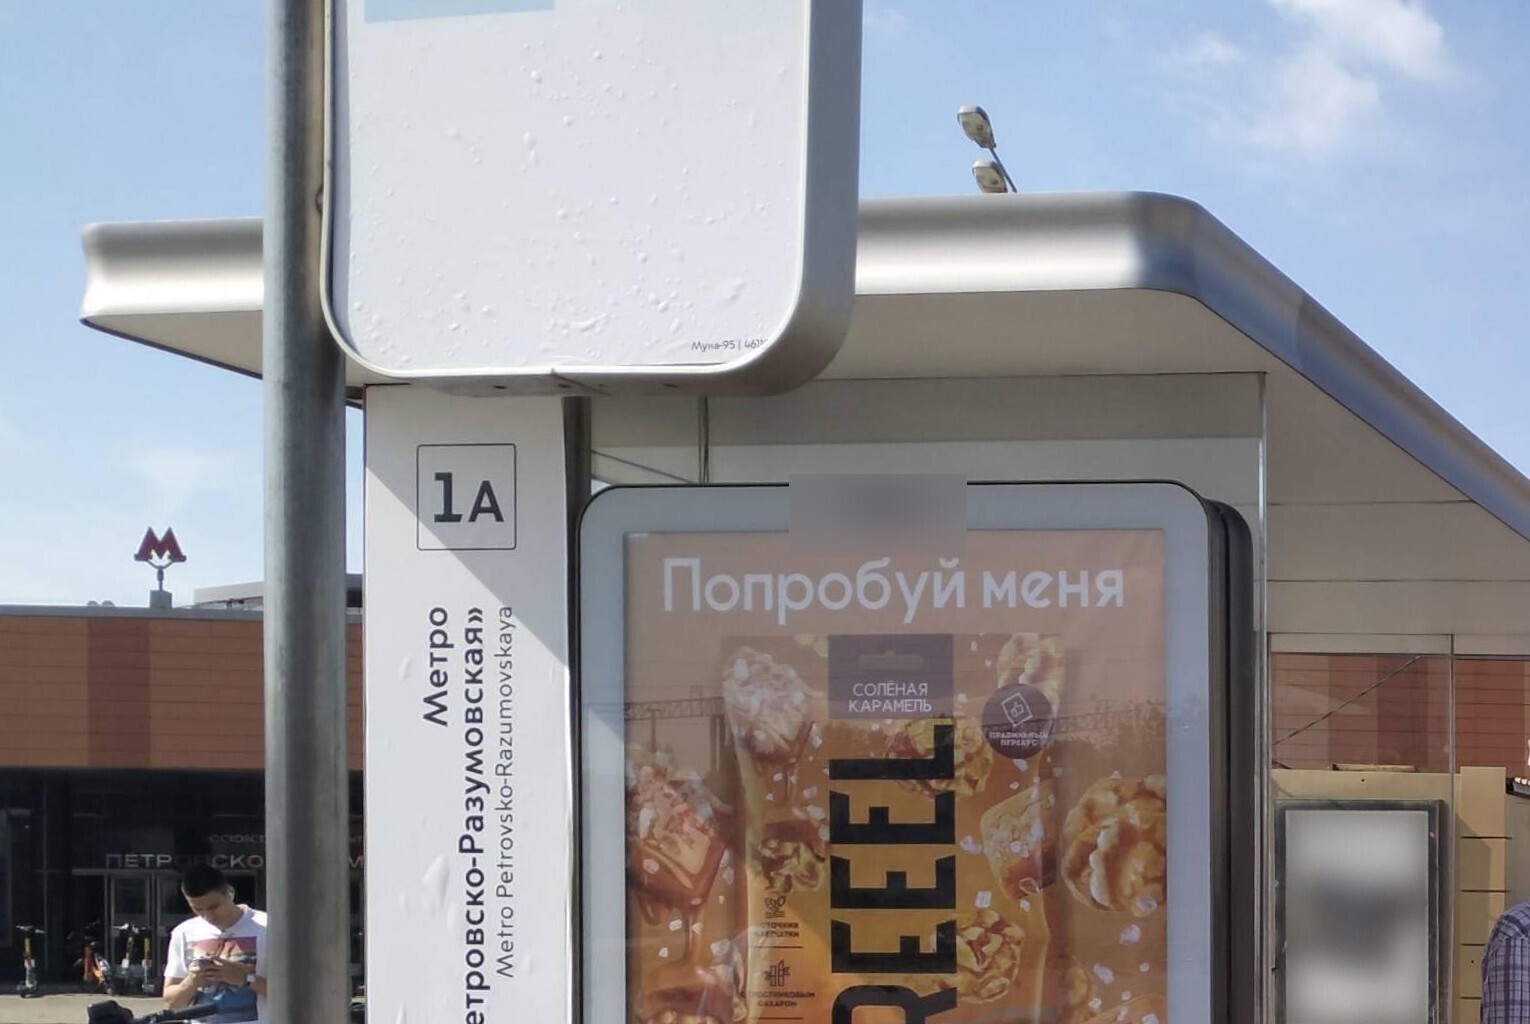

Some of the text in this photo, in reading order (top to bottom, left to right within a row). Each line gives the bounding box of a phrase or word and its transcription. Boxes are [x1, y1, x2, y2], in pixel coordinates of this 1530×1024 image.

[663, 557, 1124, 625] Попробуй меня
[423, 607, 454, 727] Метро
[852, 679, 929, 697] СОЛЁНАЯ
[848, 699, 933, 714] КАРАМЕЛЬ
[494, 607, 517, 979] Metro Petrovsko-Razumovskaya
